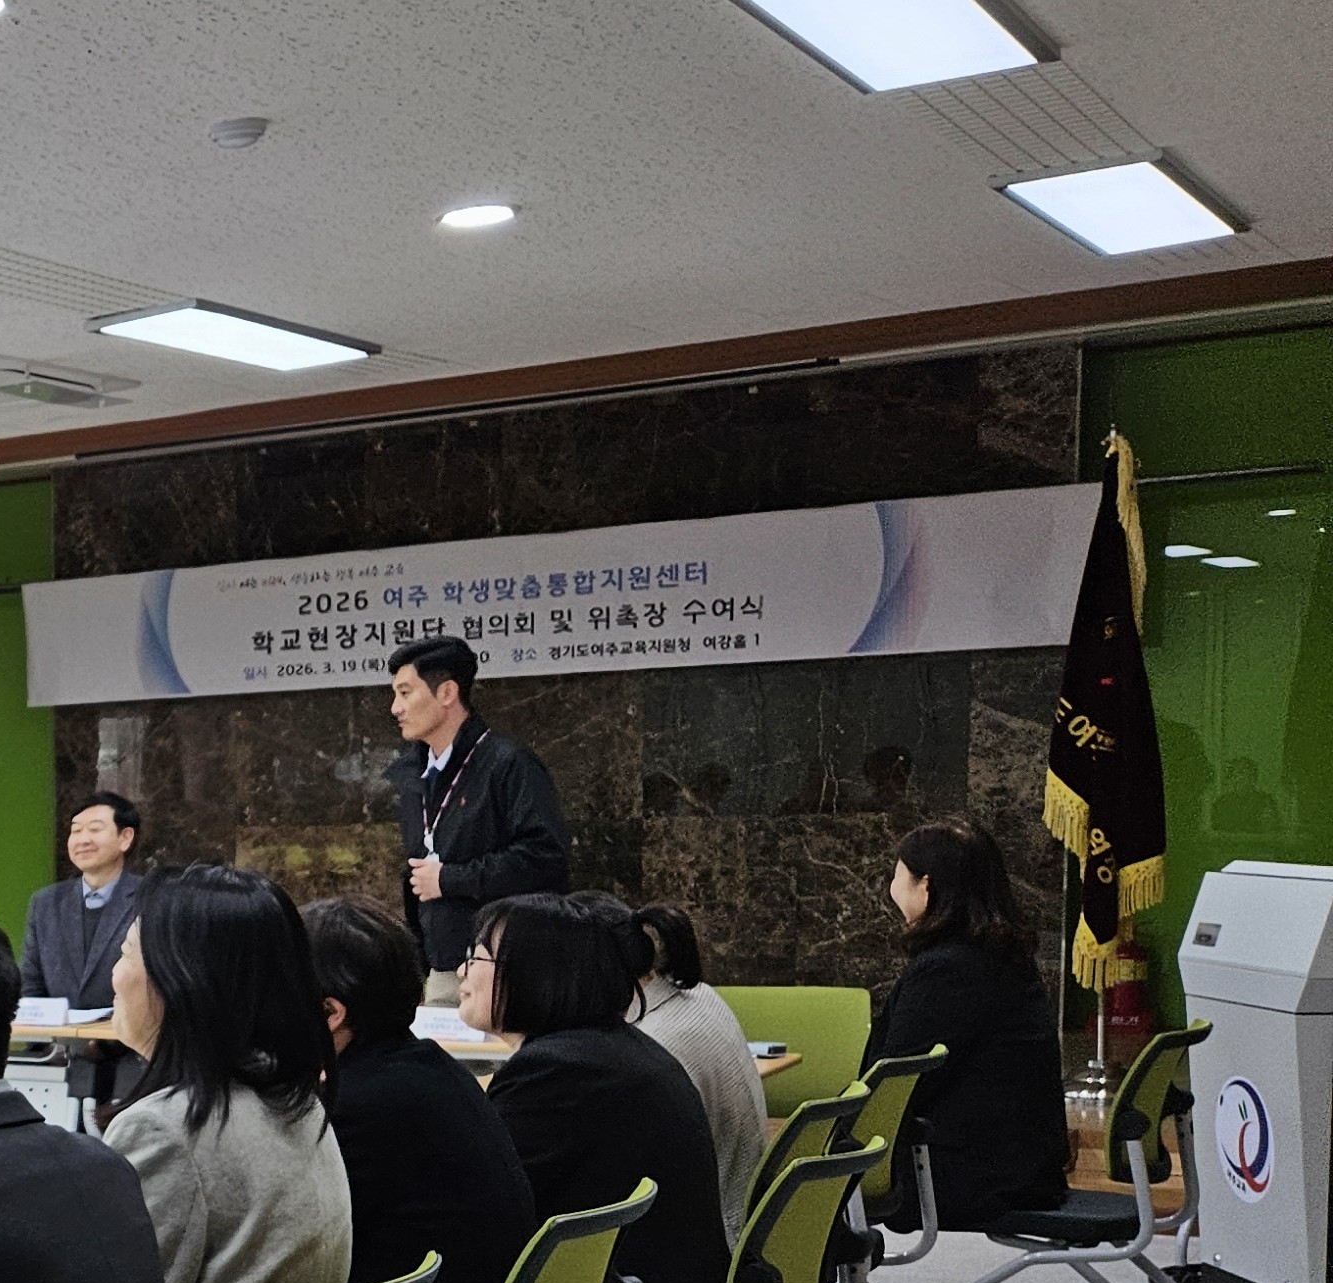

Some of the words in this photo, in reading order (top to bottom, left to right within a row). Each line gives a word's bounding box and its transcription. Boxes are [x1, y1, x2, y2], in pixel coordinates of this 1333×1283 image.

[298, 589, 369, 616] 2026
[383, 584, 429, 609] 여주
[442, 560, 709, 604] 학생맞춤통합지원센터
[251, 616, 447, 655] 학교현장지원단
[462, 611, 535, 641] 협의회
[550, 607, 573, 635] 및
[587, 601, 668, 631] 위촉장
[682, 594, 765, 625] 수여식
[243, 665, 268, 681] 일시
[276, 661, 318, 677] 2026.
[322, 660, 336, 674] 3.
[341, 658, 357, 673] 19
[510, 647, 537, 663] 장소
[548, 635, 692, 661] 경기도여주교육지원청
